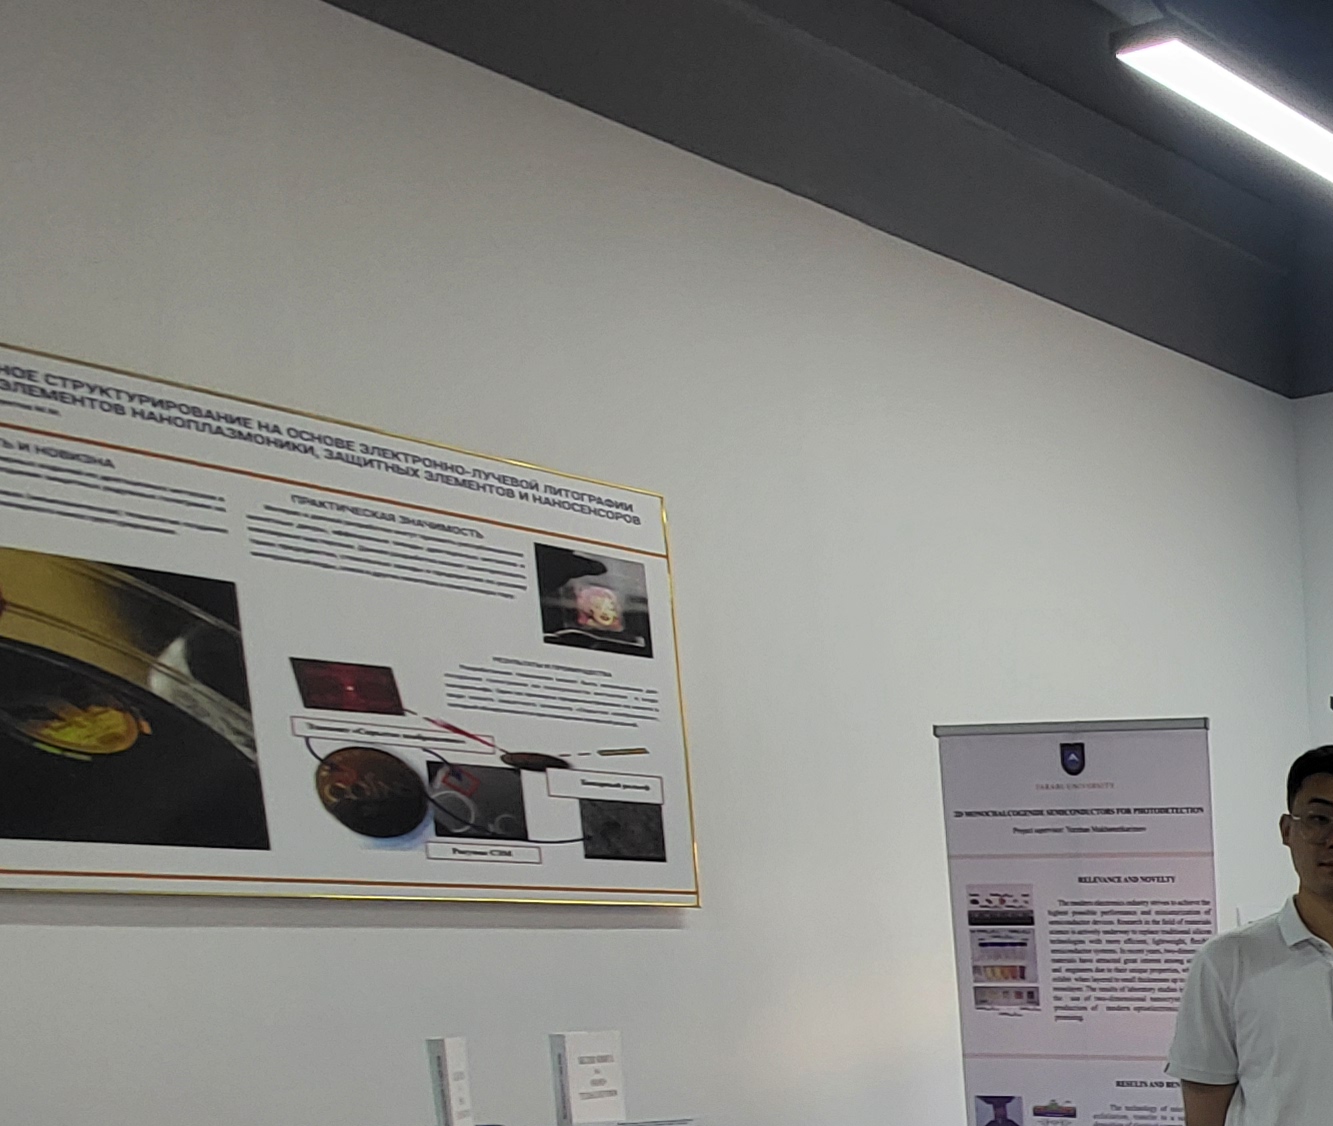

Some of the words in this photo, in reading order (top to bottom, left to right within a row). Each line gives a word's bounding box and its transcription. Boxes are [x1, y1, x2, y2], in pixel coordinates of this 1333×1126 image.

[44, 373, 254, 429] СТРУКТУРИРОВАНИЕ
[257, 417, 284, 435] НА
[287, 427, 356, 453] ОСНОВЕ
[359, 442, 540, 491] ЭЛЕКТРОННО-ЛУЧЕВОЙ
[544, 483, 634, 513] ЛИТОГРАФИИ
[324, 449, 420, 480] ЗАЩИТНЫХ
[424, 470, 515, 500] ЭЛЕМЕНТОВ
[518, 489, 530, 502] И
[532, 493, 641, 526] НАНОСЕНСОРОВ
[1115, 807, 1132, 816] FOR
[1078, 876, 1122, 884] RELEVANCE
[1124, 876, 1139, 884] AND
[1140, 876, 1176, 884] NOVELTY
